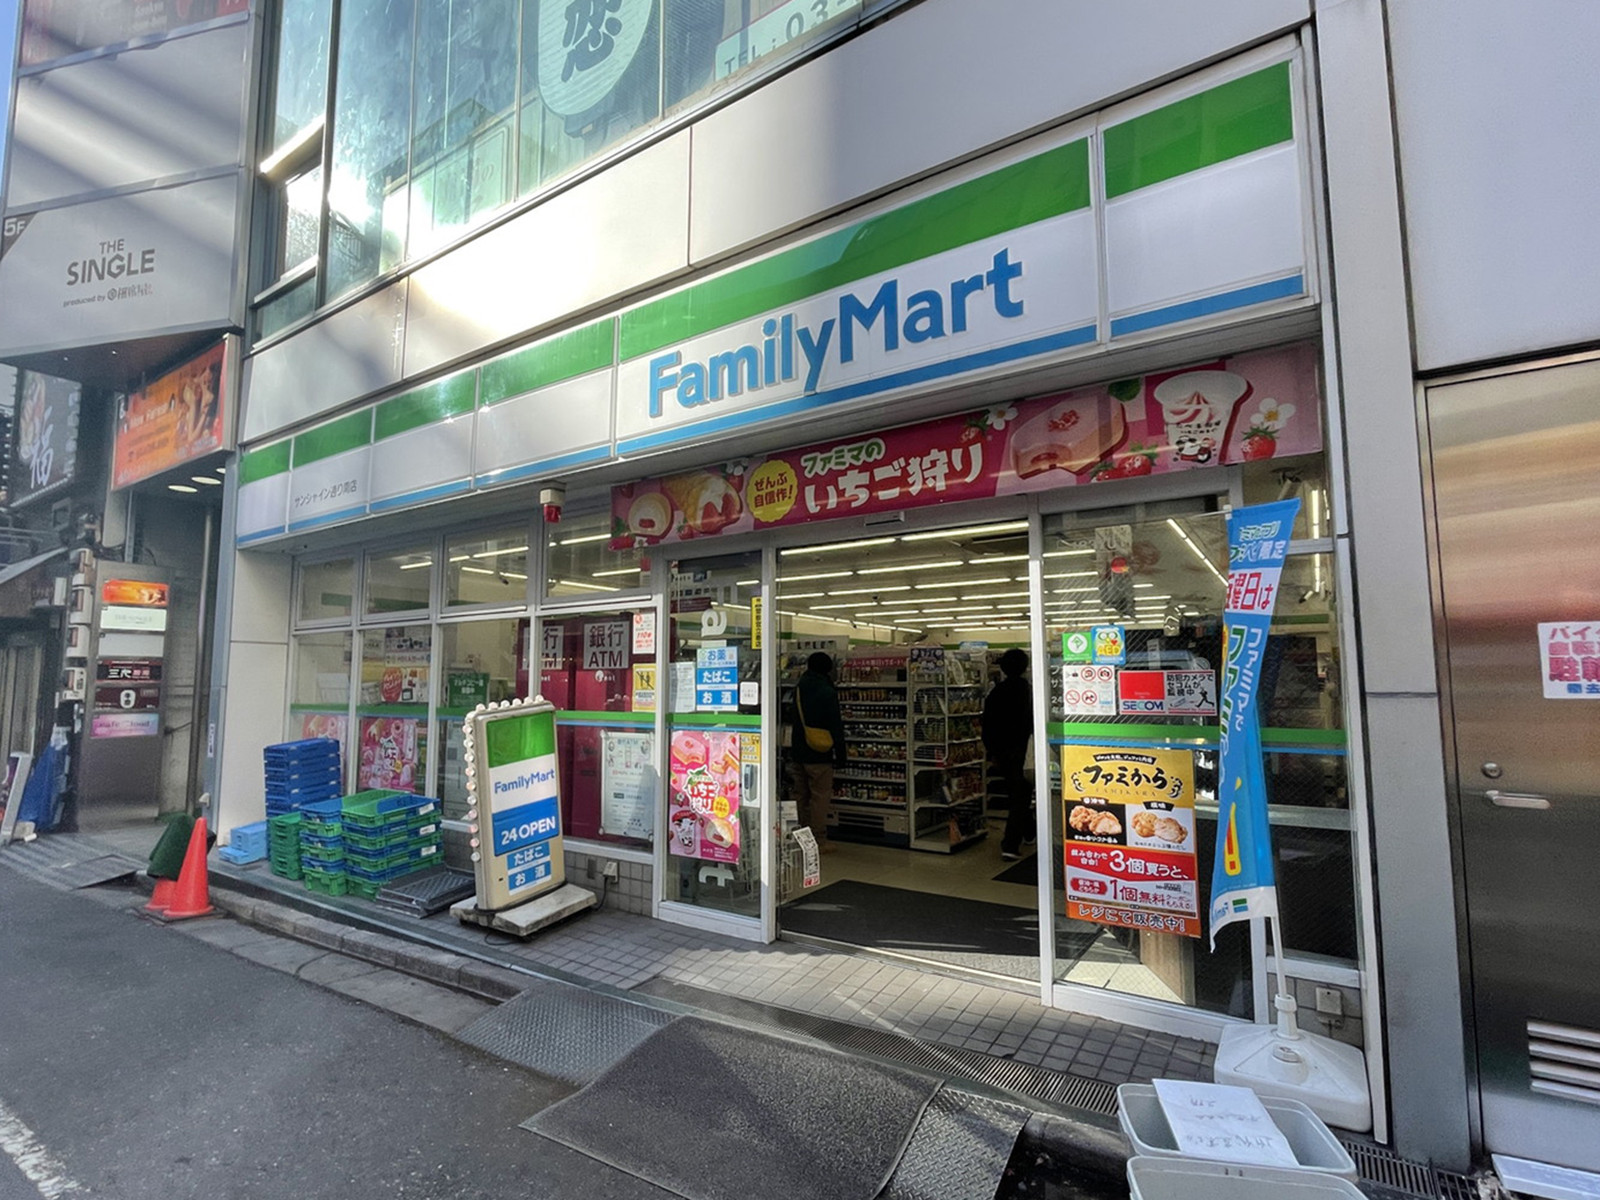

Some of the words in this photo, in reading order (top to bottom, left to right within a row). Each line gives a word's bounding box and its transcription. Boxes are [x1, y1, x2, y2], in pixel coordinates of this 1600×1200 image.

[99, 239, 125, 254] THE
[66, 249, 156, 286] SINGLE
[648, 247, 1025, 419] FamilyMart
[801, 437, 885, 478] ファミマの
[754, 472, 789, 493] ぜんぶ
[804, 442, 984, 514] いちご狩り
[589, 623, 624, 649] 銀行
[1549, 625, 1600, 641] バイ
[588, 650, 623, 668] ATM
[707, 649, 727, 661] お薬
[1096, 645, 1122, 657] AED
[702, 670, 732, 683] たばこ
[1167, 674, 1214, 682] 防犯カメラで
[1167, 681, 1201, 690] セコムが
[702, 691, 732, 704] お酒
[1167, 688, 1196, 697] 監視中
[1123, 701, 1164, 711] SECOM
[494, 768, 555, 794] FamilyMart
[1083, 764, 1168, 790] ファミから
[501, 826, 518, 846] 24
[518, 815, 557, 839] OPEN
[514, 846, 544, 866] たばこ
[515, 863, 546, 887] お酒
[1079, 903, 1186, 932] レジにて販売中!
